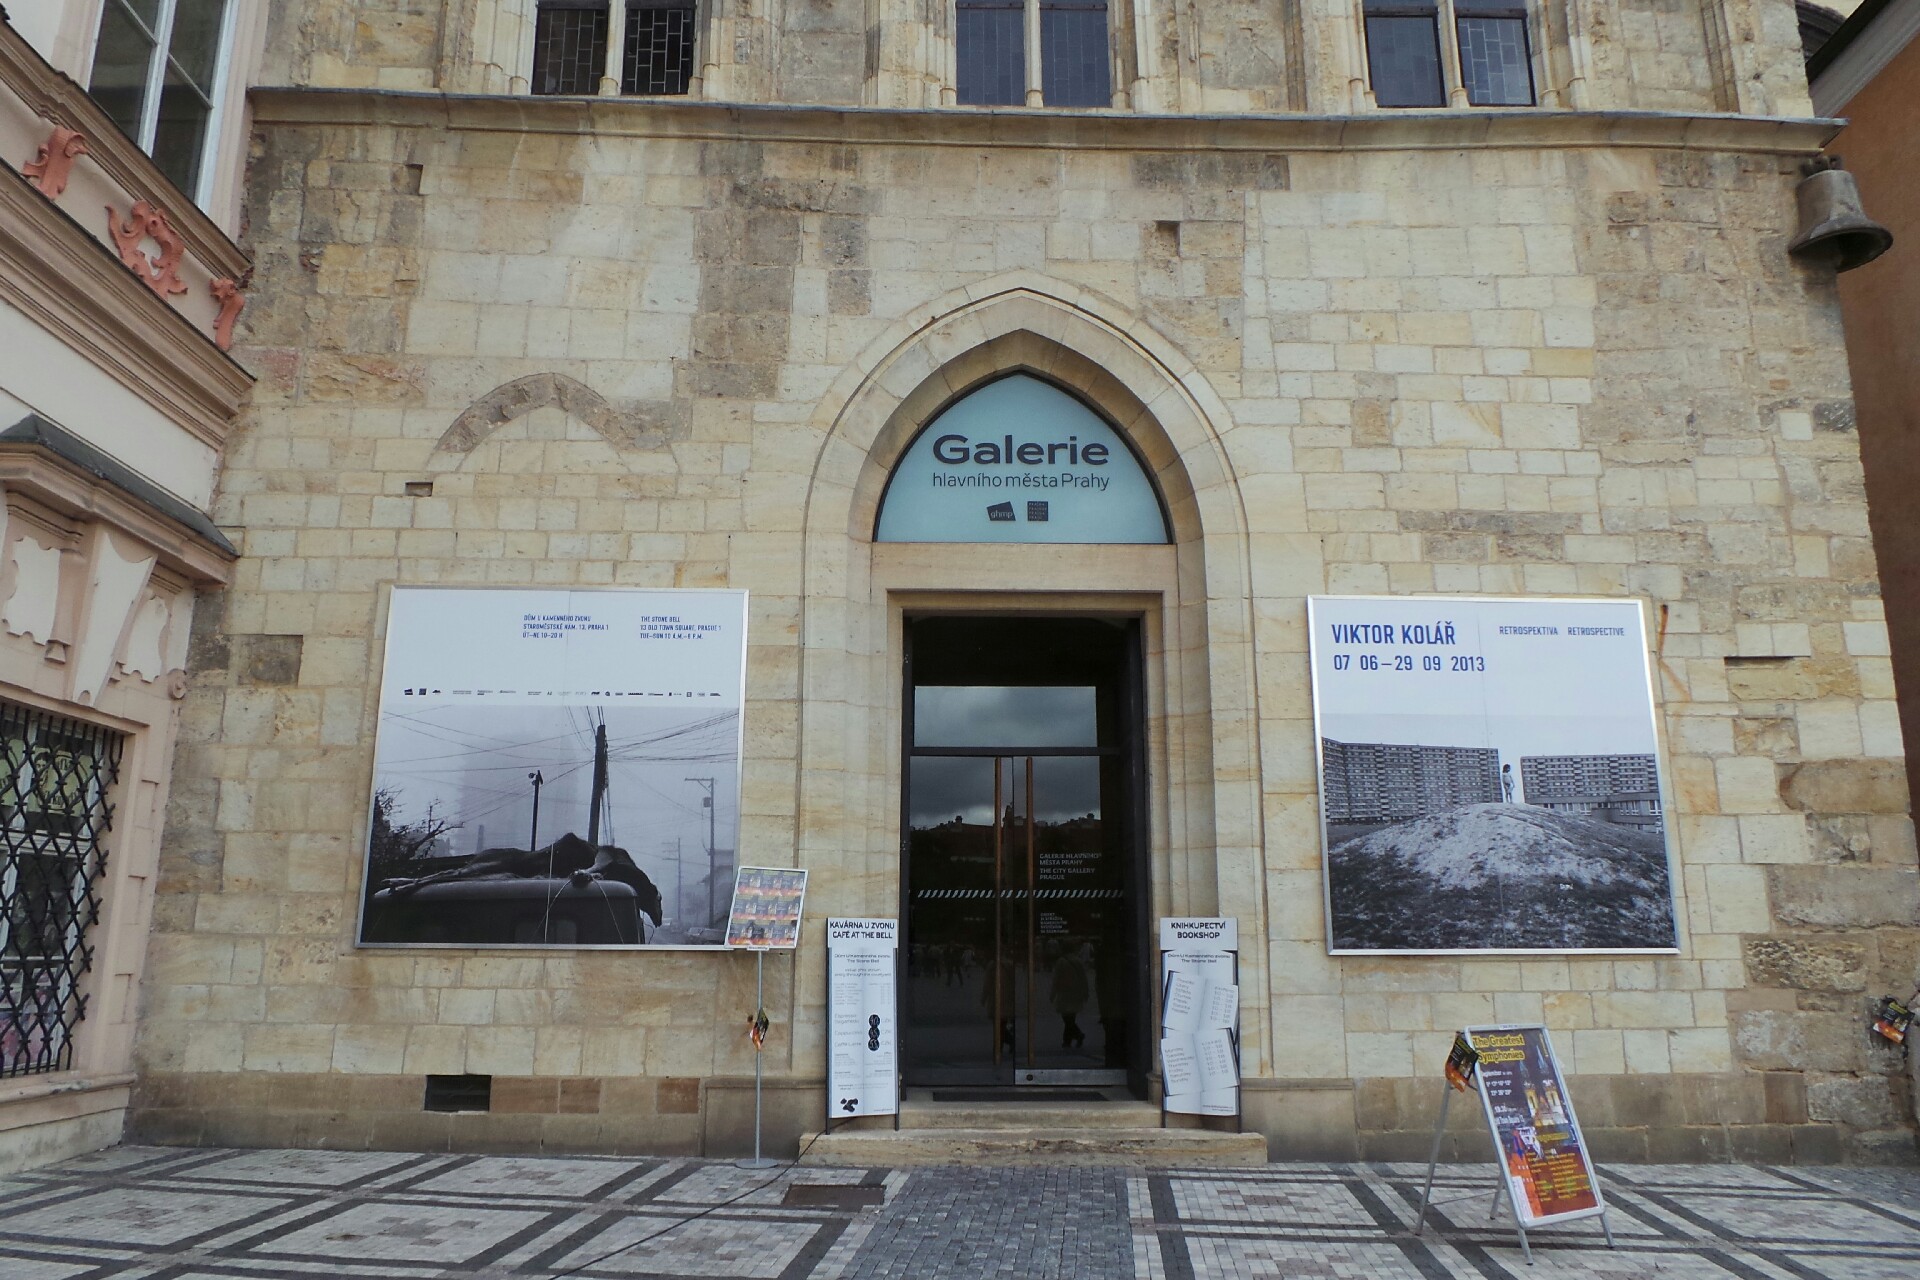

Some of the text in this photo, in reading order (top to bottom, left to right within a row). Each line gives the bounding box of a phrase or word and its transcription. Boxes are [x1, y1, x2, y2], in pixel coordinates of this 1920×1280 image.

[933, 434, 1109, 465] Galerie
[933, 472, 1110, 491] hlavního města Prahy
[990, 510, 1013, 518] ghmp
[1331, 620, 1456, 646] VIKTOR KOLÁŘ
[1499, 626, 1625, 636] RETROSPEKTIVA RETROSPECTIVE
[1333, 655, 1350, 671] 07
[1423, 656, 1441, 672] 09
[1451, 656, 1485, 672] 2013
[830, 921, 863, 929] KAVÁRNA
[871, 922, 895, 930] ZVONU
[1171, 921, 1226, 929] KNIHKUPECTVÍ
[833, 930, 850, 939] CAFÉ
[1177, 931, 1220, 939] BOOKSHOP
[1472, 1035, 1524, 1047] The Greatest
[1478, 1049, 1525, 1064] Symphonies
